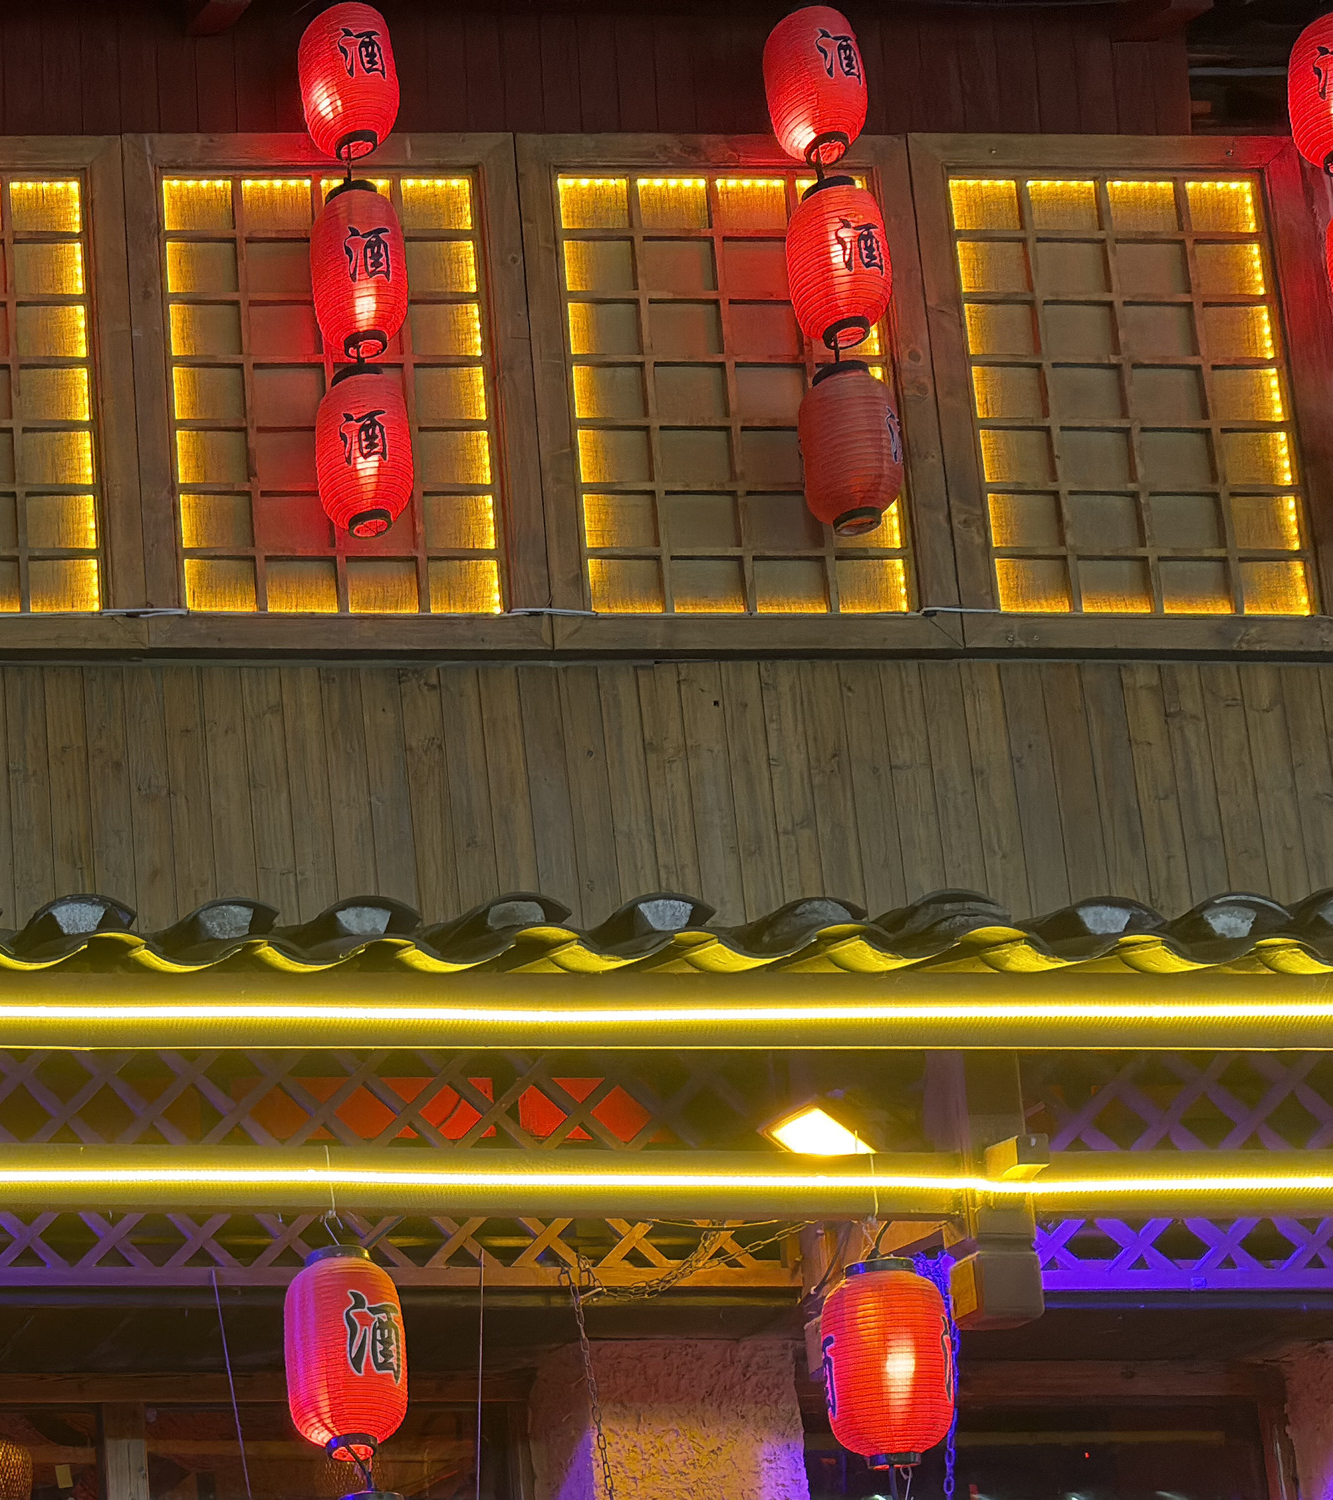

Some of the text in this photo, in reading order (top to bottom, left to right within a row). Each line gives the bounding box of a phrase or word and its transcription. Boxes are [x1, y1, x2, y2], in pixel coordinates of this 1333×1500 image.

[337, 27, 385, 80] 酒
[816, 29, 861, 83] 酒
[345, 226, 391, 281] 酒
[835, 218, 885, 274] 酒
[339, 410, 386, 464] 酒
[346, 1290, 401, 1383] 酒
